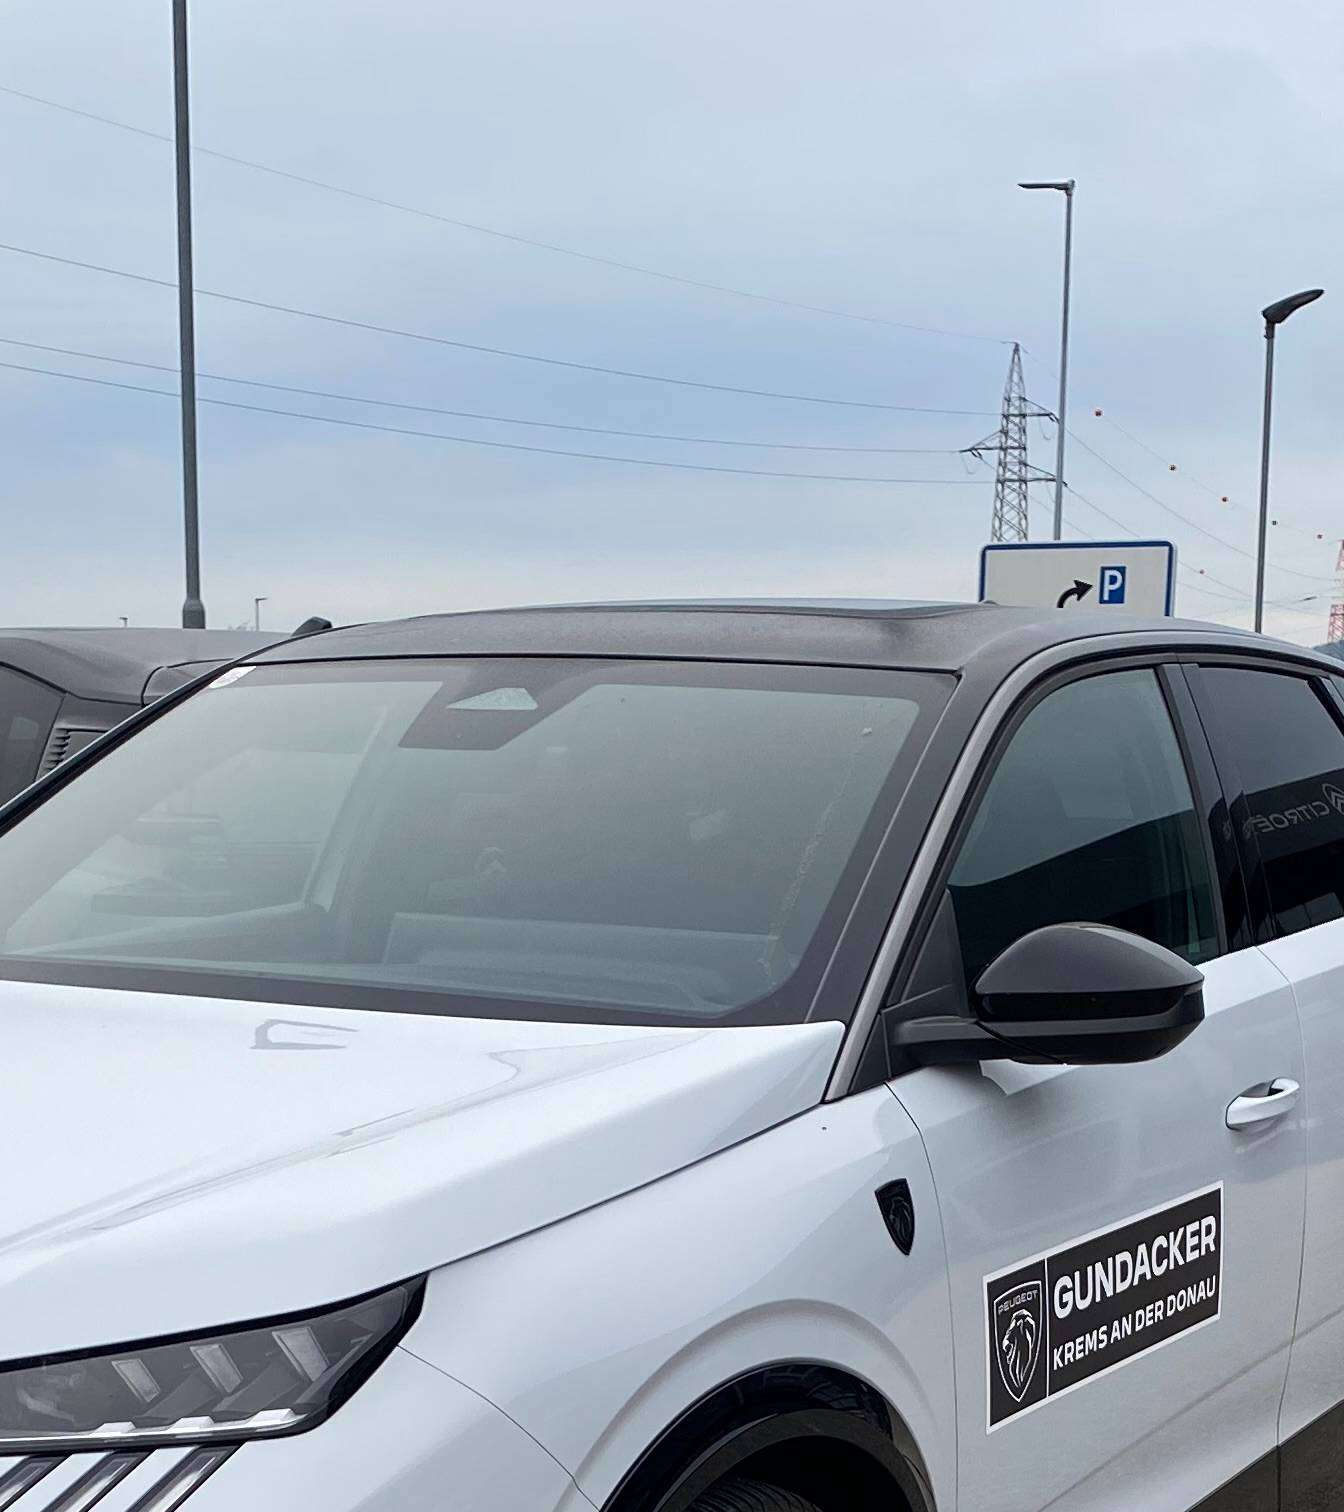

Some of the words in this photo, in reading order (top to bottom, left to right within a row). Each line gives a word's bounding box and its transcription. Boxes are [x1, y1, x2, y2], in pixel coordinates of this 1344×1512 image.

[1103, 570, 1123, 601] P
[1053, 1215, 1217, 1319] GUNDACKER
[997, 1289, 1039, 1315] PEUGEOT
[1053, 1325, 1109, 1371] KREMS
[1110, 1313, 1133, 1344] AN
[1135, 1299, 1164, 1333] DER
[1166, 1275, 1217, 1317] DONAU
